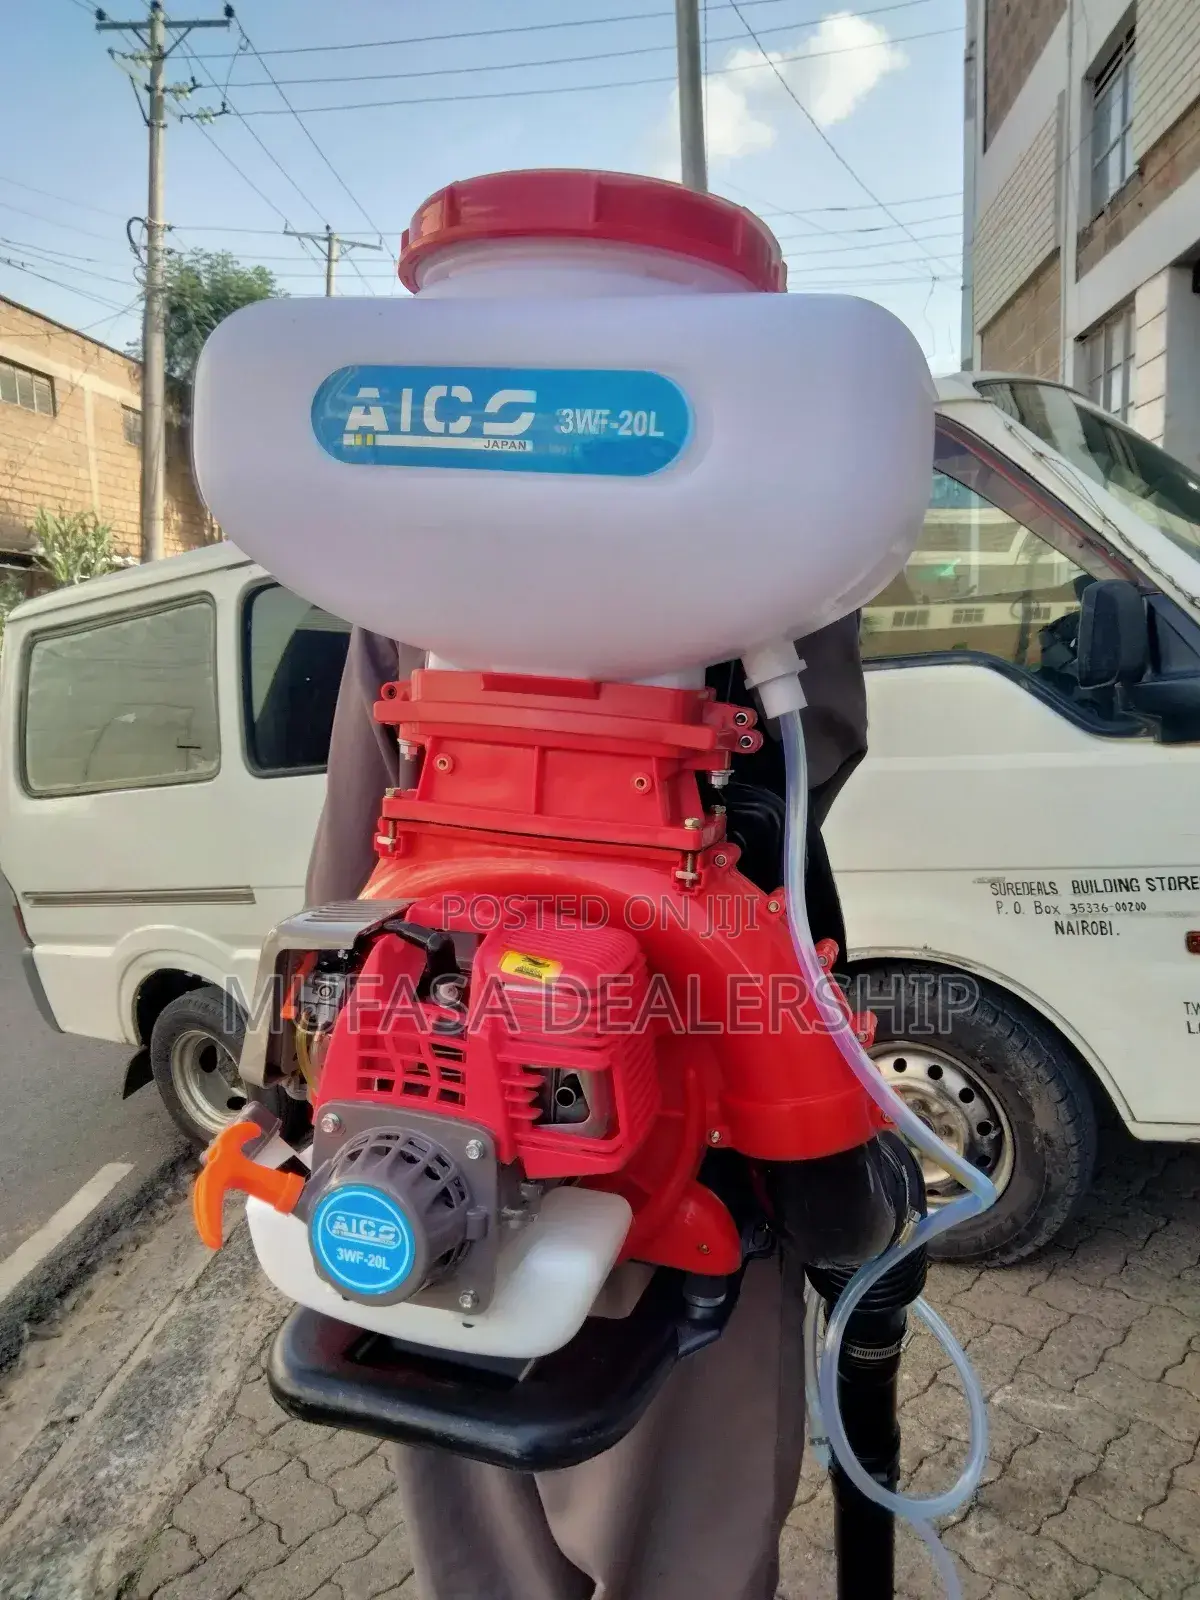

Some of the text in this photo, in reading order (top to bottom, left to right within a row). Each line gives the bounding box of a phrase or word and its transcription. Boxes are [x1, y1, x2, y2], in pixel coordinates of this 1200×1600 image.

[345, 385, 537, 435] AICS
[559, 408, 665, 437] 3WF-20L
[484, 439, 527, 452] JAPAN
[990, 875, 1200, 896] SUREDEALS BUILDING STORE
[1034, 900, 1061, 915] Box
[1070, 902, 1147, 914] 35336-00200
[1054, 920, 1120, 936] NAIROBI.
[331, 1215, 397, 1242] AICS
[336, 1247, 391, 1271] 3WF-20L
